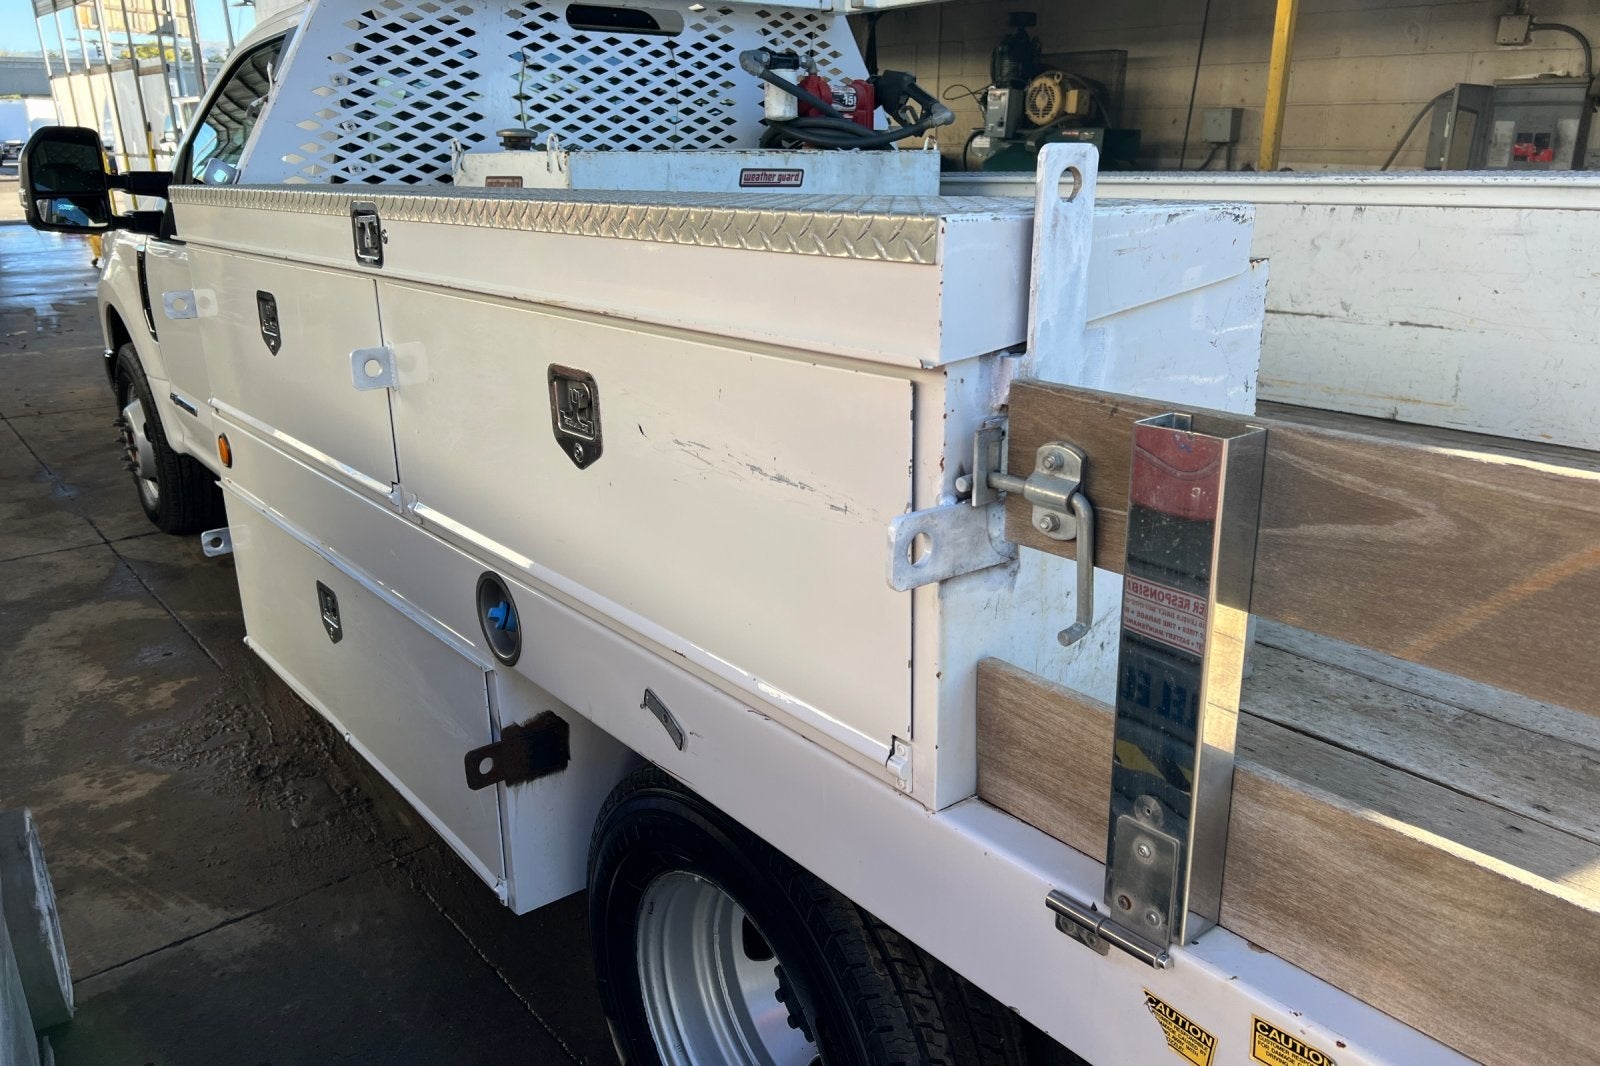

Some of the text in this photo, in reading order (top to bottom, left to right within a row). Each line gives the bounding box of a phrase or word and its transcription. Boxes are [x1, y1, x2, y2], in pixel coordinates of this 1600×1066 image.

[743, 171, 800, 183] weather guard
[1145, 994, 1212, 1048] CAUTION
[1177, 1033, 1199, 1052] CAUSED
[1199, 1049, 1206, 1057] BY
[1258, 1034, 1290, 1056] CUSTOMER
[1258, 1040, 1295, 1065] FOR DAMAGE
